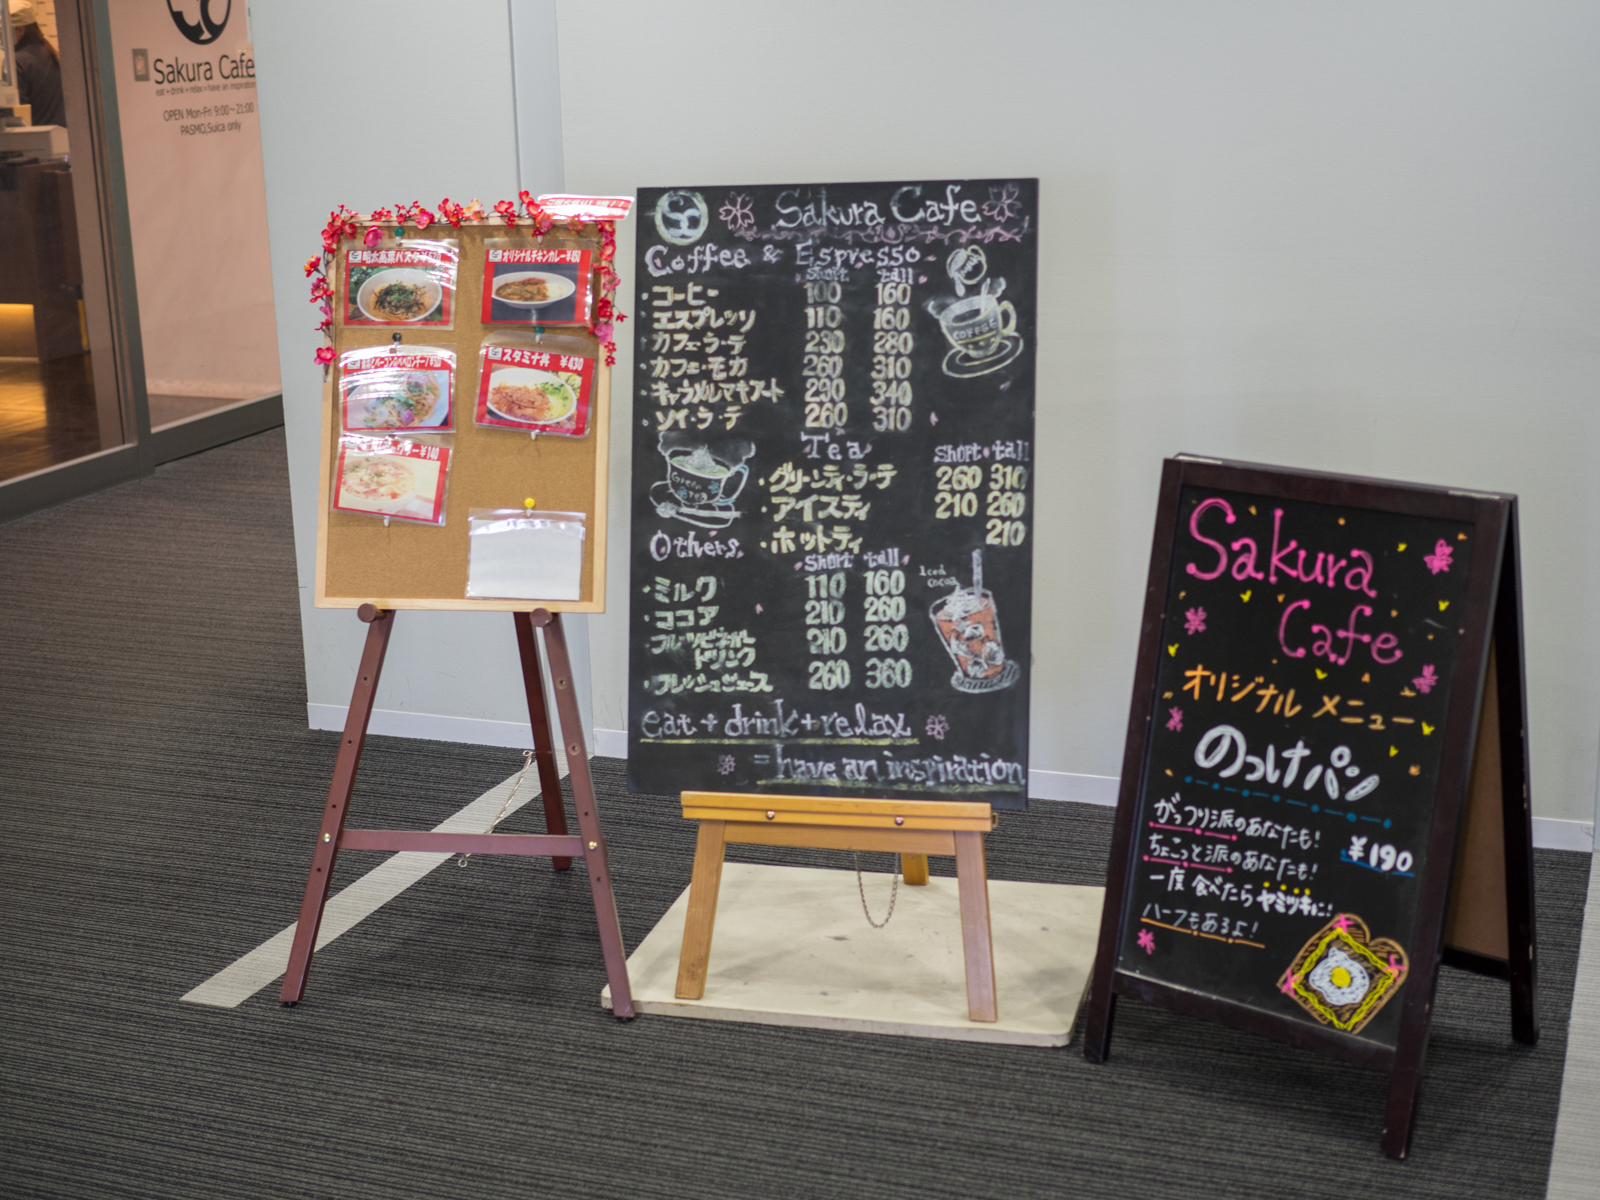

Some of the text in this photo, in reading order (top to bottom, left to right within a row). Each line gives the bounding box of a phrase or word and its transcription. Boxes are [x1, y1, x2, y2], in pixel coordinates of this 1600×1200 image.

[154, 53, 256, 84] Sakura Cafe
[170, 86, 184, 95] drink
[208, 83, 220, 92] have
[230, 81, 256, 90] inspiration
[164, 109, 184, 122] OPEN
[186, 106, 212, 120] Mon-Fri
[228, 120, 242, 132] only
[775, 185, 982, 228] Sakura Cafe
[645, 239, 921, 277] Coffee & Espresso
[652, 281, 911, 306] コーヒー 100 160
[804, 305, 842, 329] 110
[873, 306, 910, 330] 160
[503, 348, 550, 367] スタミナ丼
[804, 330, 845, 354] 230
[874, 331, 914, 354] 280
[802, 354, 843, 378] 260
[870, 354, 912, 380] 310
[651, 377, 912, 406] キャラメルマキアート 290 340
[804, 402, 848, 428] 260
[872, 406, 912, 432] 310
[800, 431, 865, 460] Tea
[992, 440, 1029, 461] tall
[935, 465, 982, 491] 260
[989, 463, 1028, 490] 310
[771, 490, 1026, 522] アイスティ 210 260
[650, 530, 740, 562] Others
[771, 518, 1026, 554] ホットティ 210
[1185, 498, 1378, 598] Sakura
[863, 547, 899, 568] tall
[654, 569, 905, 604] ミルク 110 160
[654, 596, 906, 630] ココア 210 260
[806, 626, 847, 655] 210
[864, 624, 909, 652] 260
[1279, 600, 1402, 666] Cafe
[808, 659, 851, 690] 260
[865, 657, 912, 688] 360
[1183, 664, 1415, 730] オリジナル メニュー
[641, 710, 697, 739] eat
[724, 699, 799, 738] drink
[776, 743, 836, 780] have
[843, 756, 884, 782] an
[886, 751, 1026, 786] inspiration
[1194, 724, 1380, 801] のっけパン
[1348, 835, 1413, 872] ¥190
